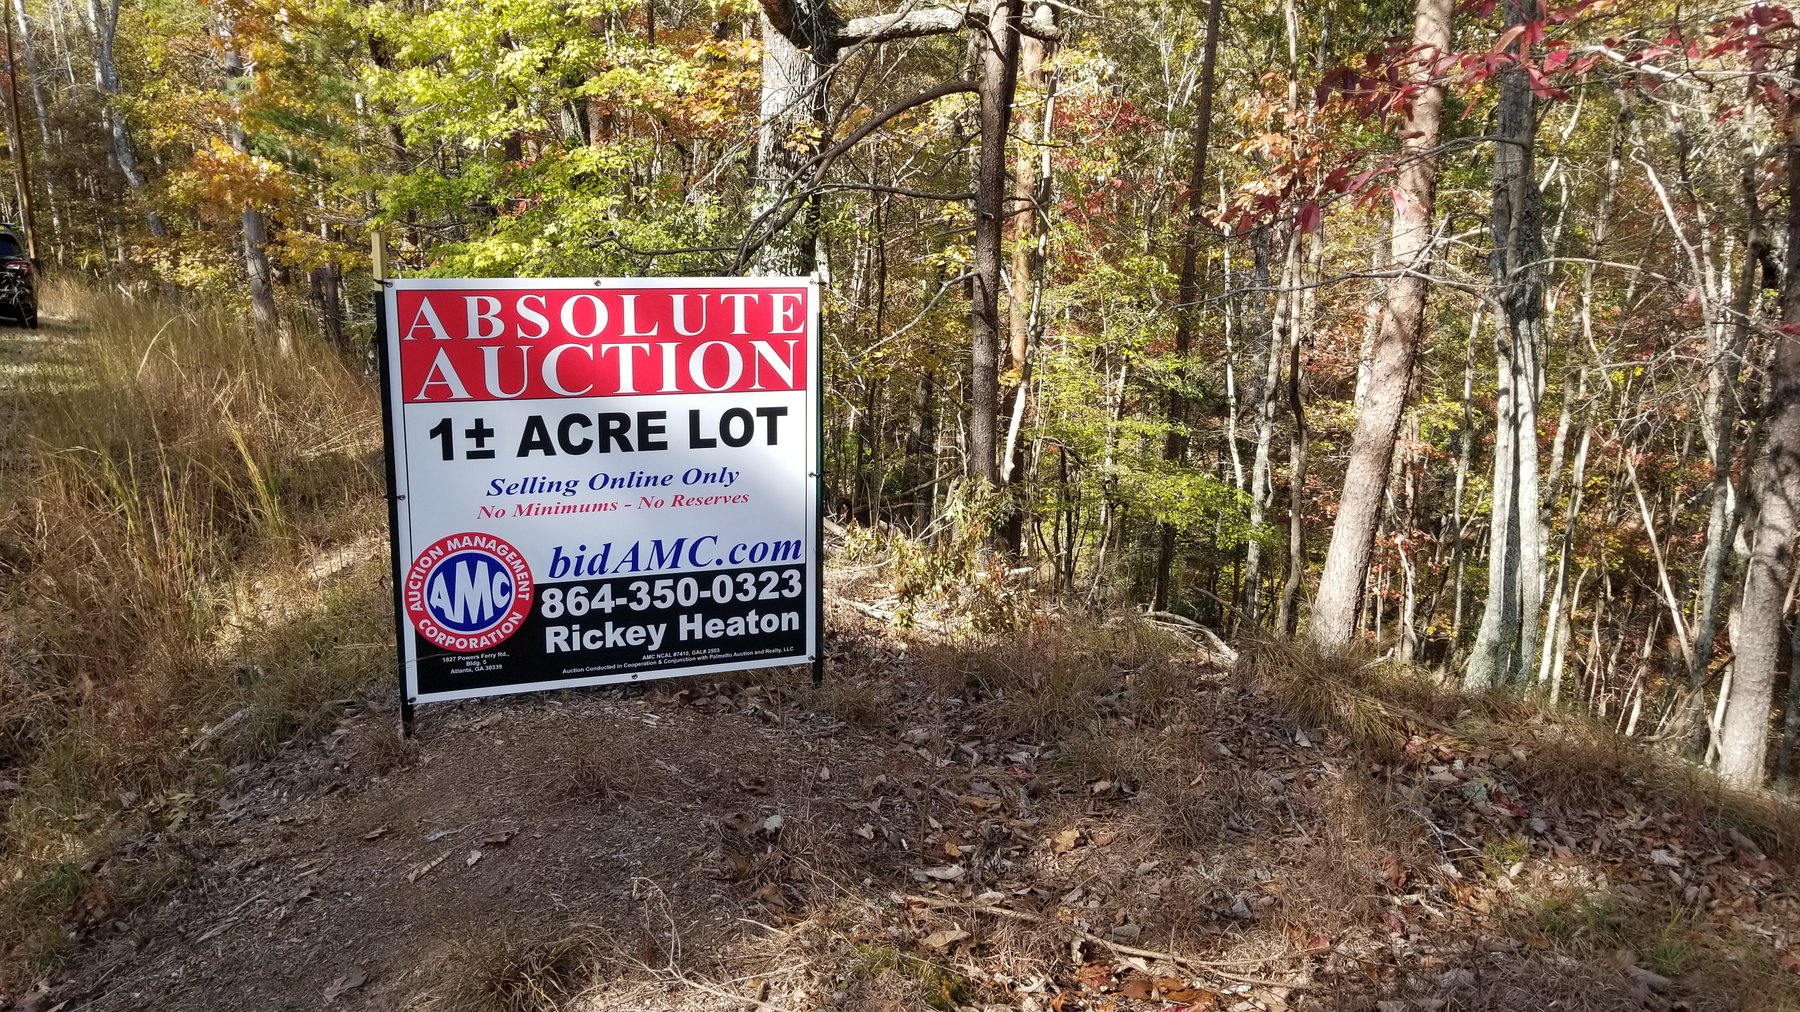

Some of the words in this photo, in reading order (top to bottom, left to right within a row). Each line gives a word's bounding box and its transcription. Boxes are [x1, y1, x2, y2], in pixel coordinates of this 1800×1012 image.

[402, 293, 805, 340] ABSOLUTE
[413, 339, 800, 400] AUCTION
[429, 417, 496, 461] 1±
[516, 410, 668, 457] ACRE
[688, 406, 788, 450] LOT
[486, 476, 580, 498] Selling
[588, 472, 674, 492] Online
[682, 466, 740, 488] Only
[477, 505, 506, 520] No
[513, 500, 619, 517] Minimums
[637, 495, 665, 510] No
[671, 492, 750, 508] Reserves
[408, 545, 444, 612] AUCTION
[446, 535, 530, 601] MANAGEMENT
[549, 535, 802, 579] bidAMC.com
[429, 560, 510, 624] AMC
[540, 569, 802, 620] 864-350-0323
[418, 611, 523, 649] CORPORATION
[545, 621, 675, 653] Rickey
[679, 609, 800, 642] Heaton
[585, 664, 616, 672] Conducted
[623, 660, 657, 668] Cooperation
[663, 656, 696, 664] Conjunction
